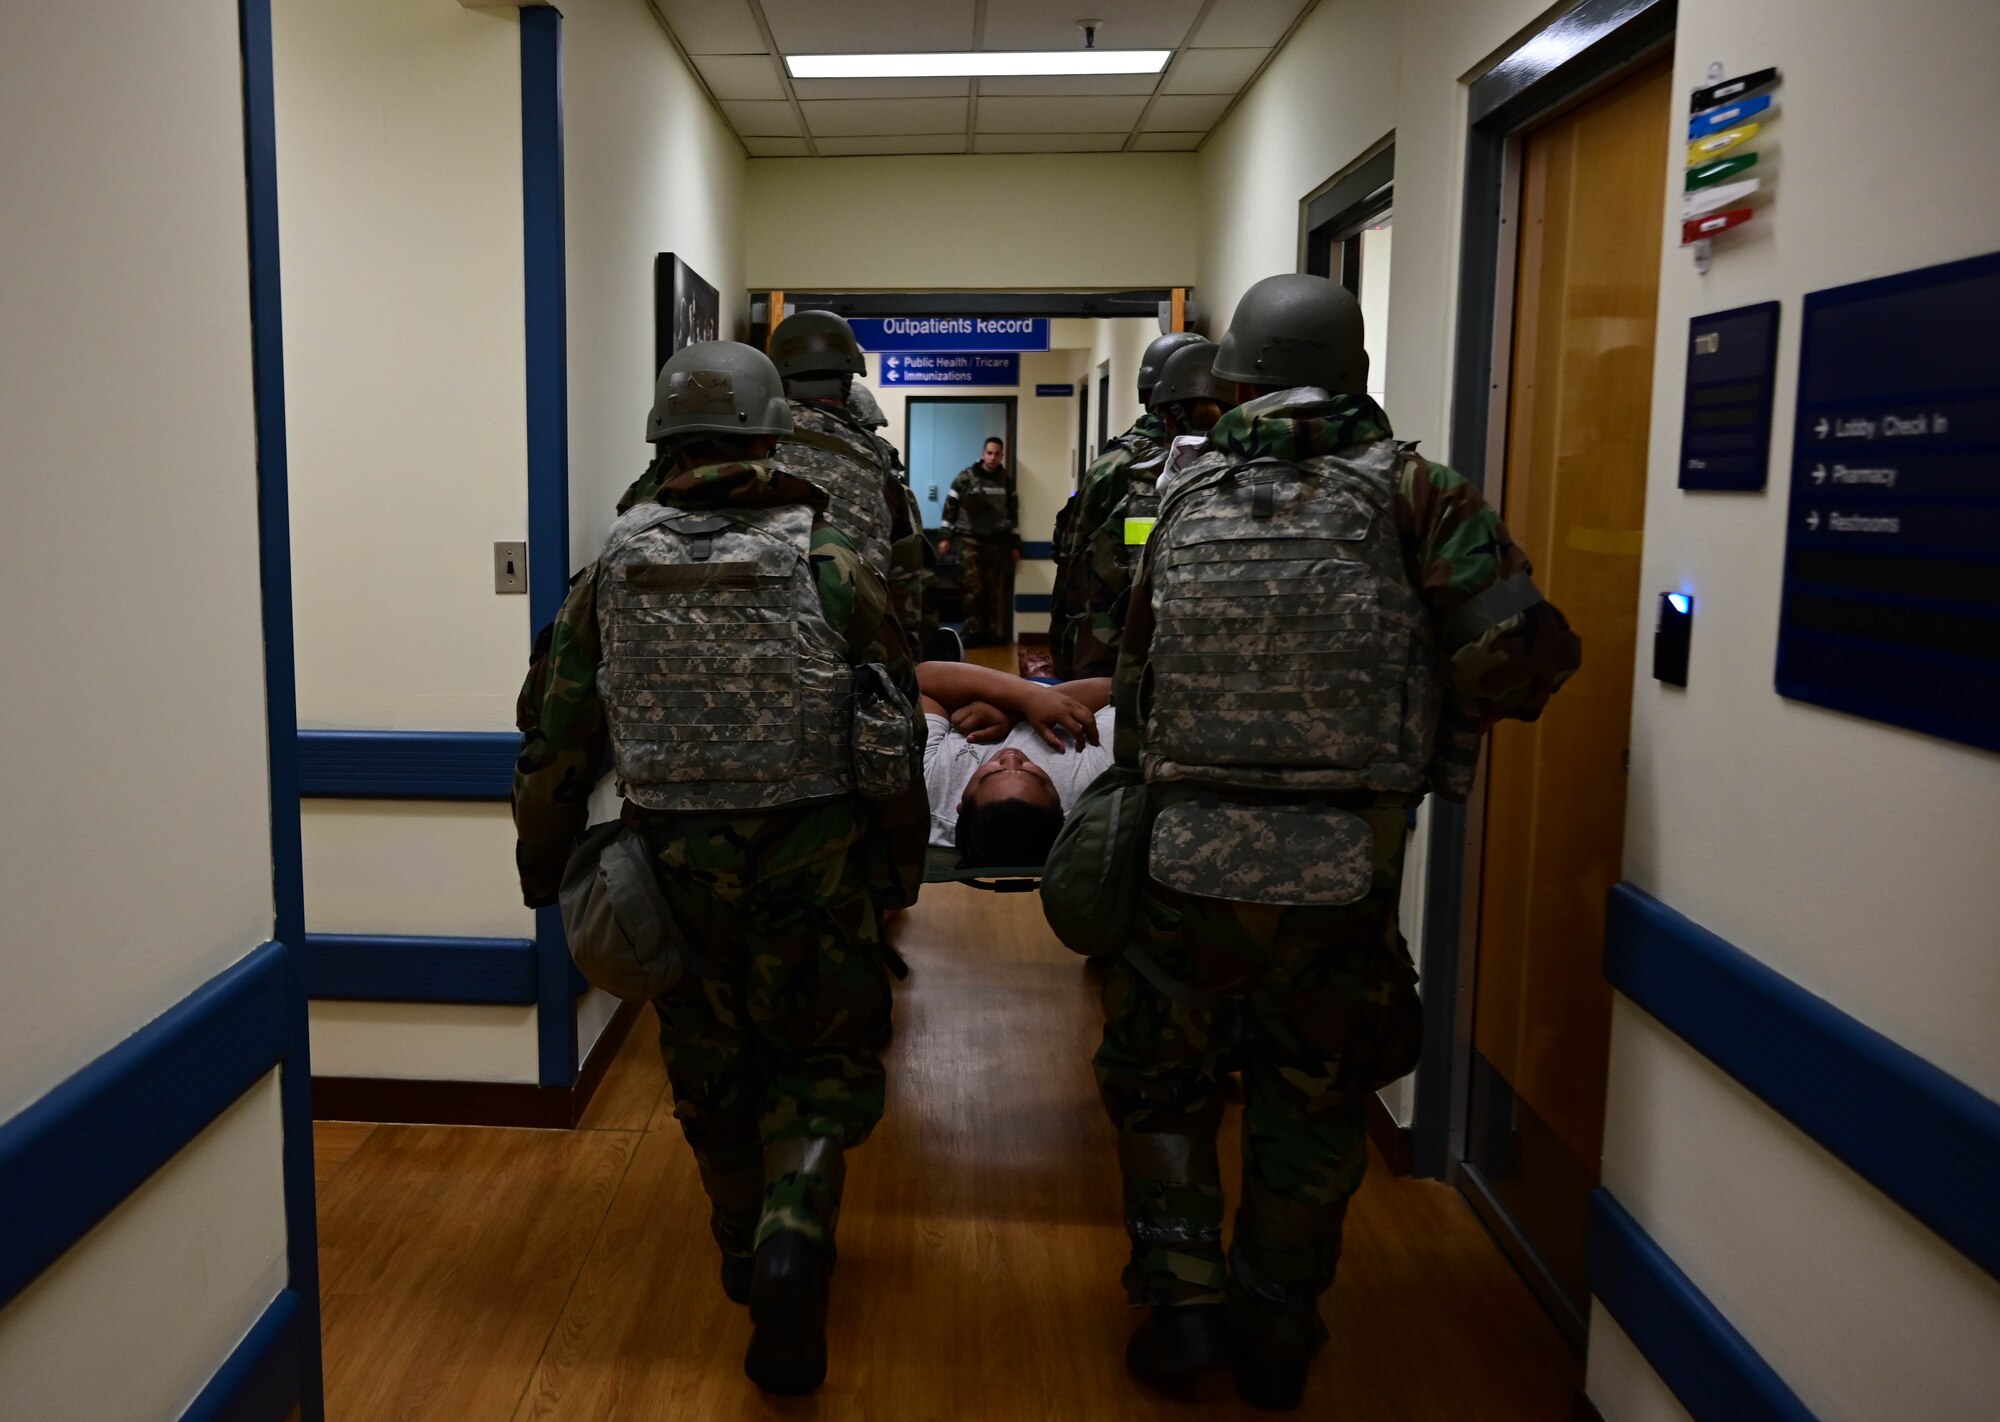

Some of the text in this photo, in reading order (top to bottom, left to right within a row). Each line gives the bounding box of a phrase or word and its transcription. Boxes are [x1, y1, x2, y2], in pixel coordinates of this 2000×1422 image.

[882, 318, 1033, 336] Outpatients Record
[904, 356, 935, 368] Public
[935, 356, 967, 368] Health
[974, 356, 1010, 368] Tricare
[903, 370, 973, 382] Immunizations
